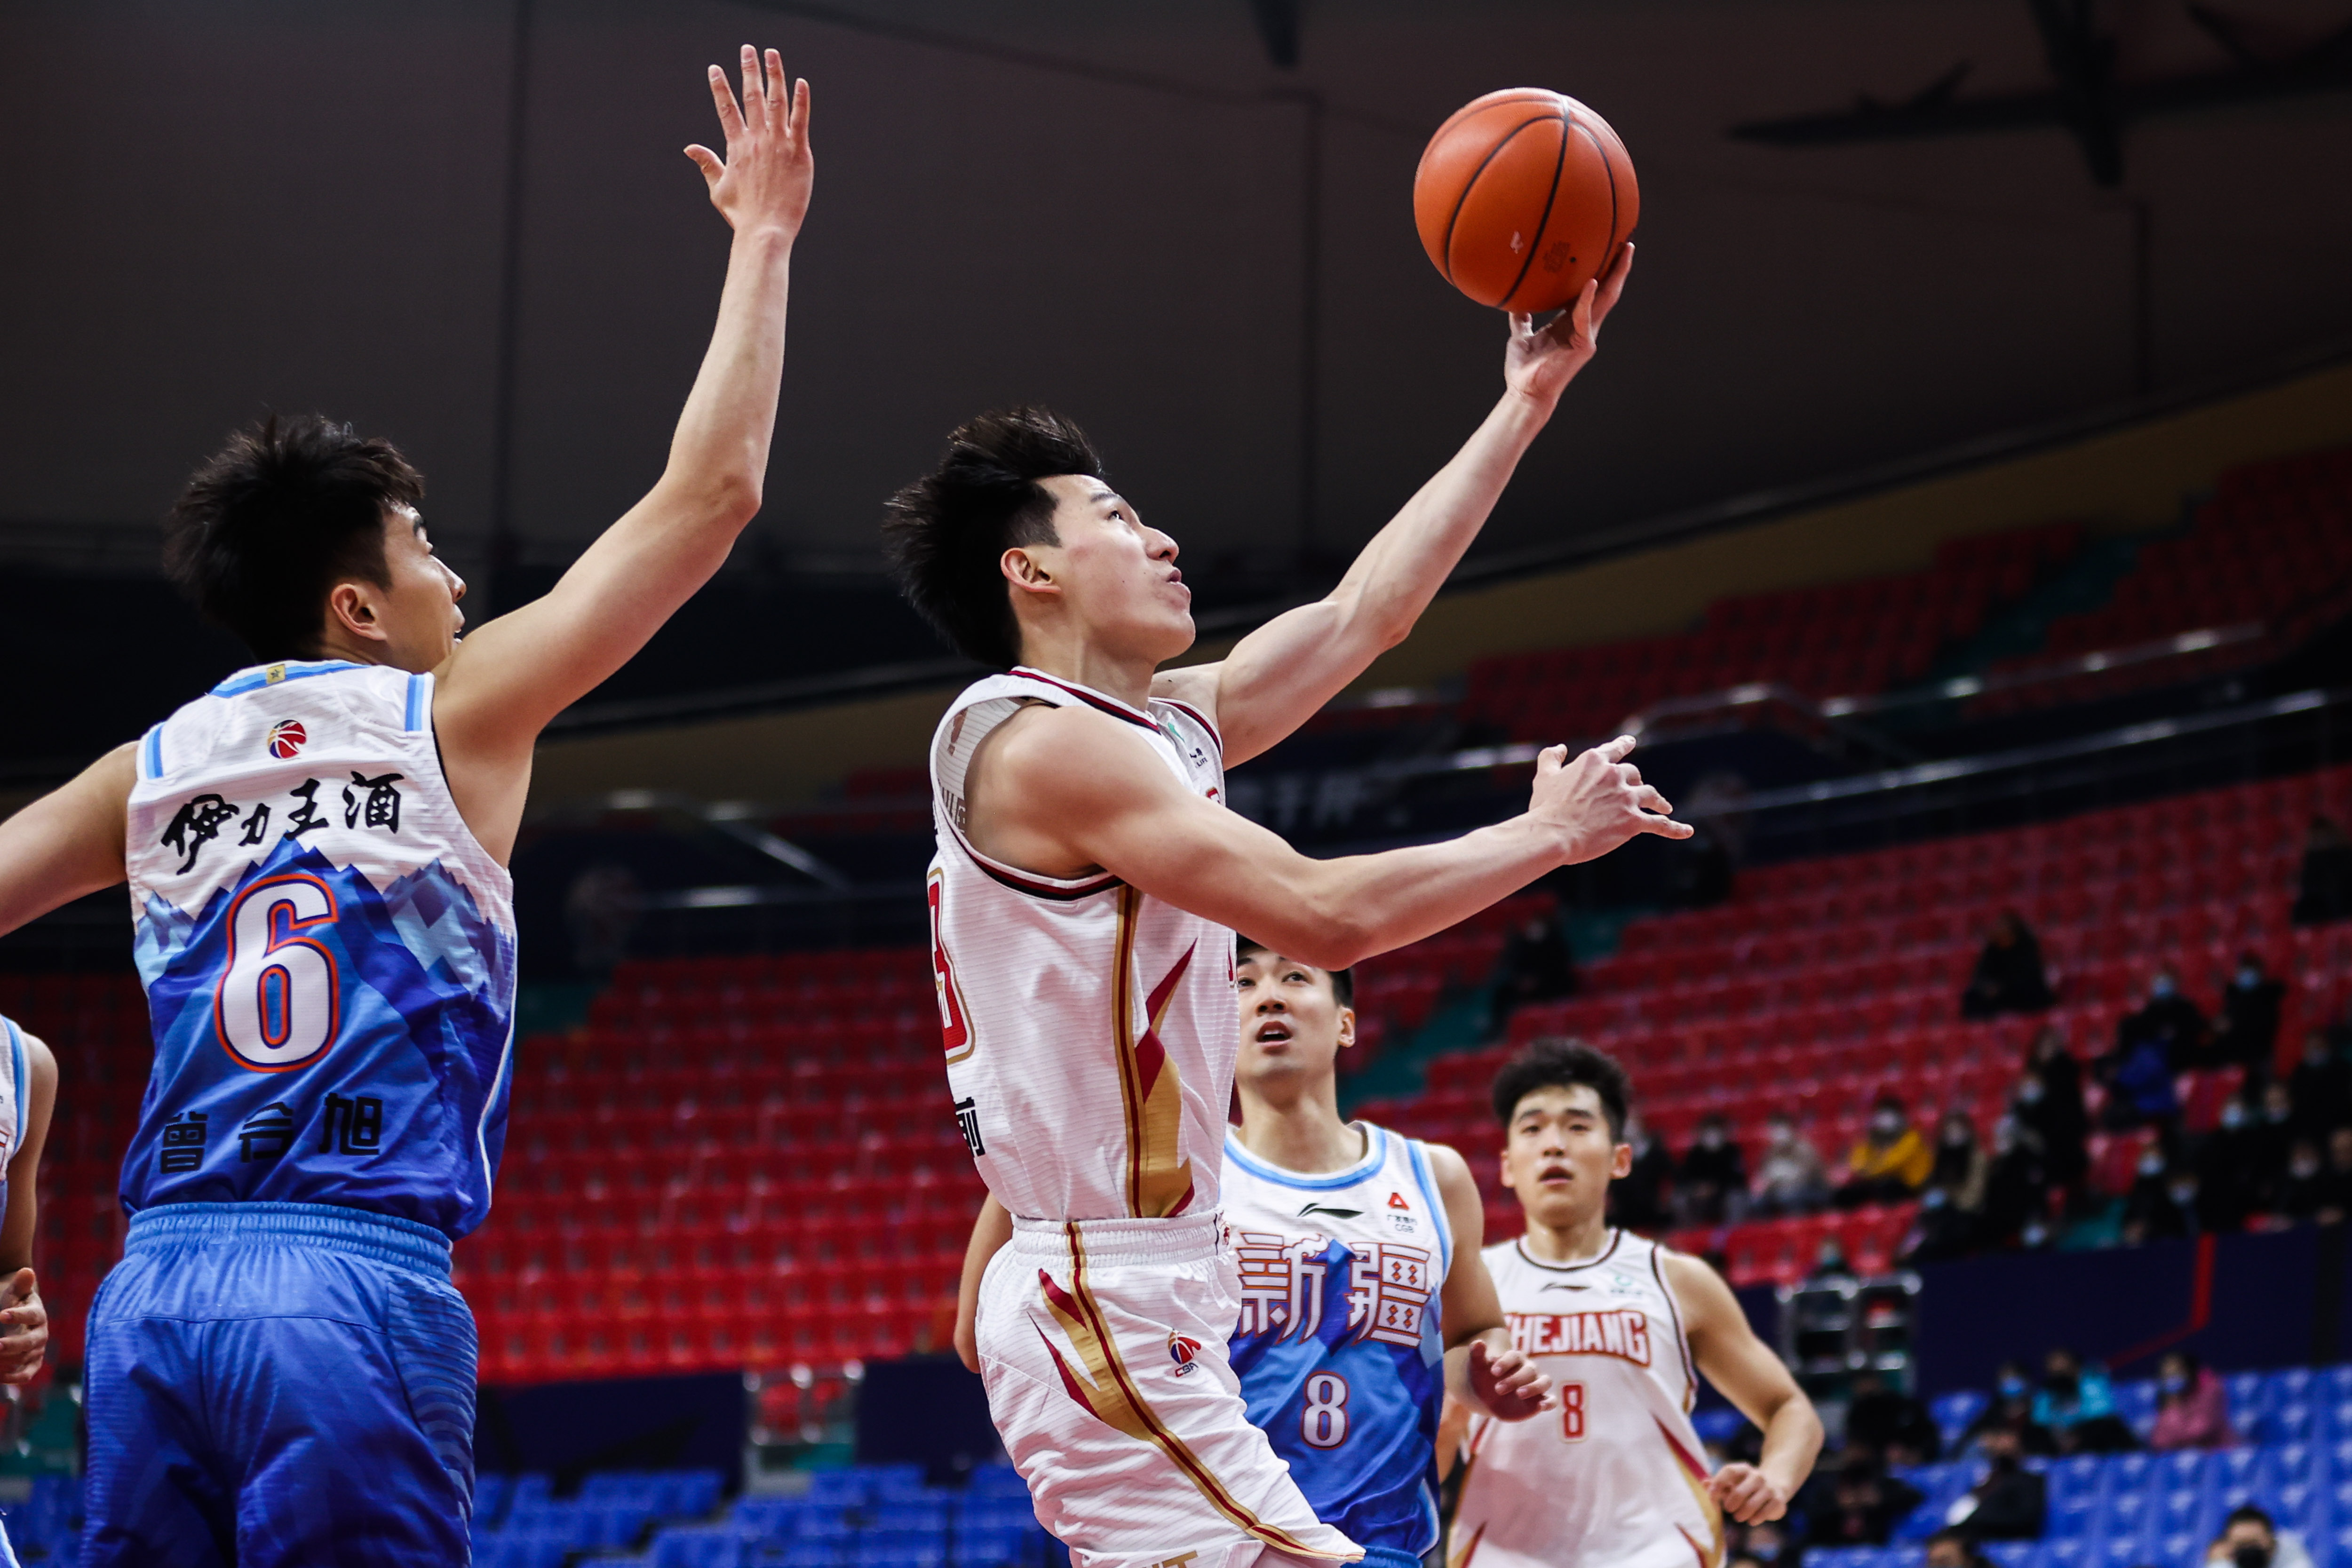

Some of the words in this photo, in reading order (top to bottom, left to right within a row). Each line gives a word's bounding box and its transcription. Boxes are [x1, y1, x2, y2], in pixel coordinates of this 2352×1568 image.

[161, 771, 405, 875] 伊力王酒
[214, 874, 339, 1074] 6
[160, 1093, 382, 1174] 曾令旭
[1395, 1224, 1414, 1233] CGB
[1235, 1232, 1431, 1348] 新疆
[1175, 1362, 1199, 1377] CBA
[1504, 1312, 1648, 1366] HEJIANG
[1300, 1370, 1350, 1450] 8
[1561, 1383, 1585, 1440] 8
